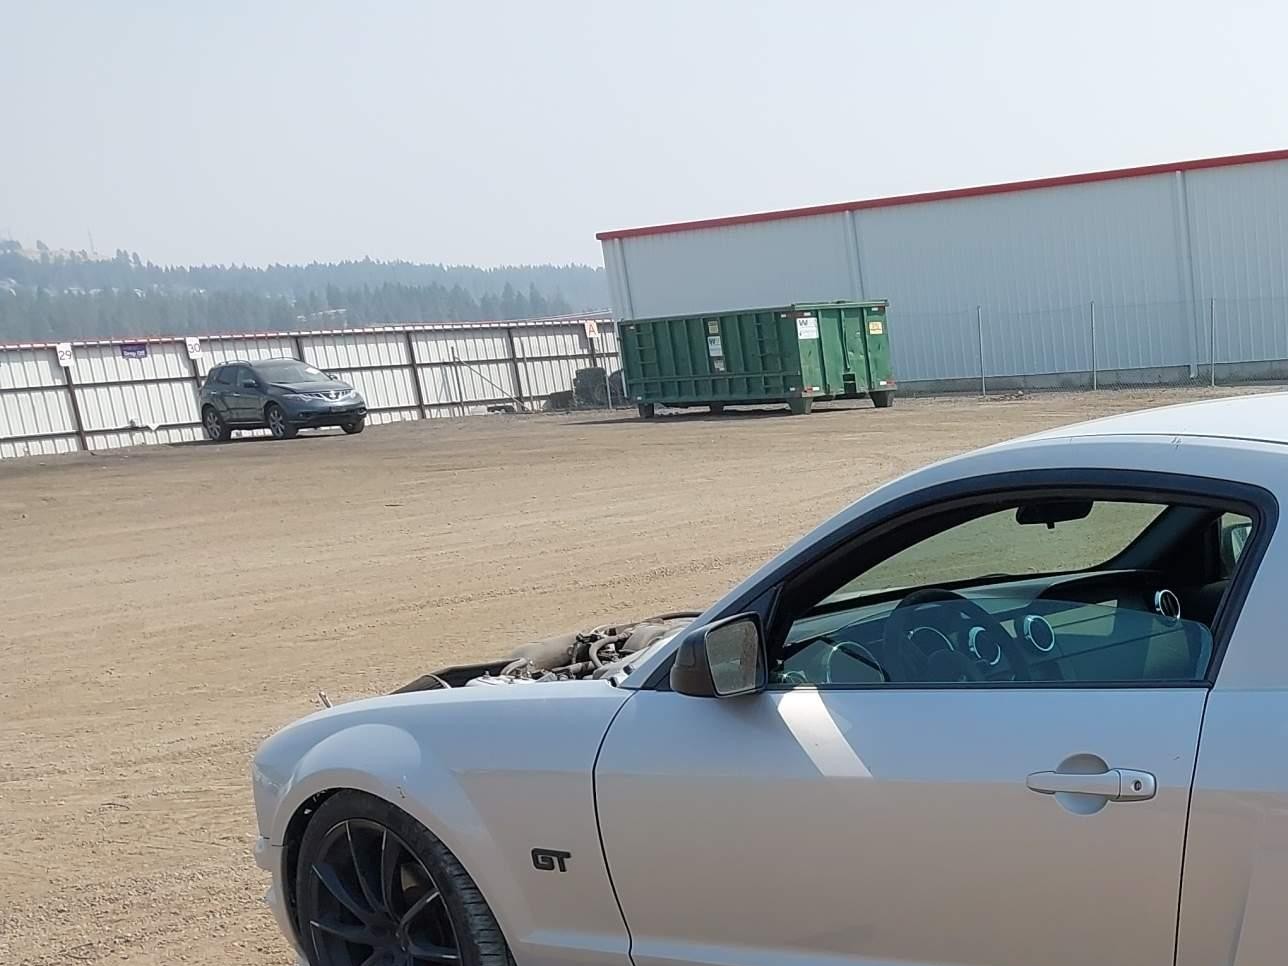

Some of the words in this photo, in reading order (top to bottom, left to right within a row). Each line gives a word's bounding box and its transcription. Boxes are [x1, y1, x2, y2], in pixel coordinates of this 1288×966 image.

[188, 343, 200, 353] 30
[59, 350, 71, 360] 29
[531, 848, 571, 872] GT
